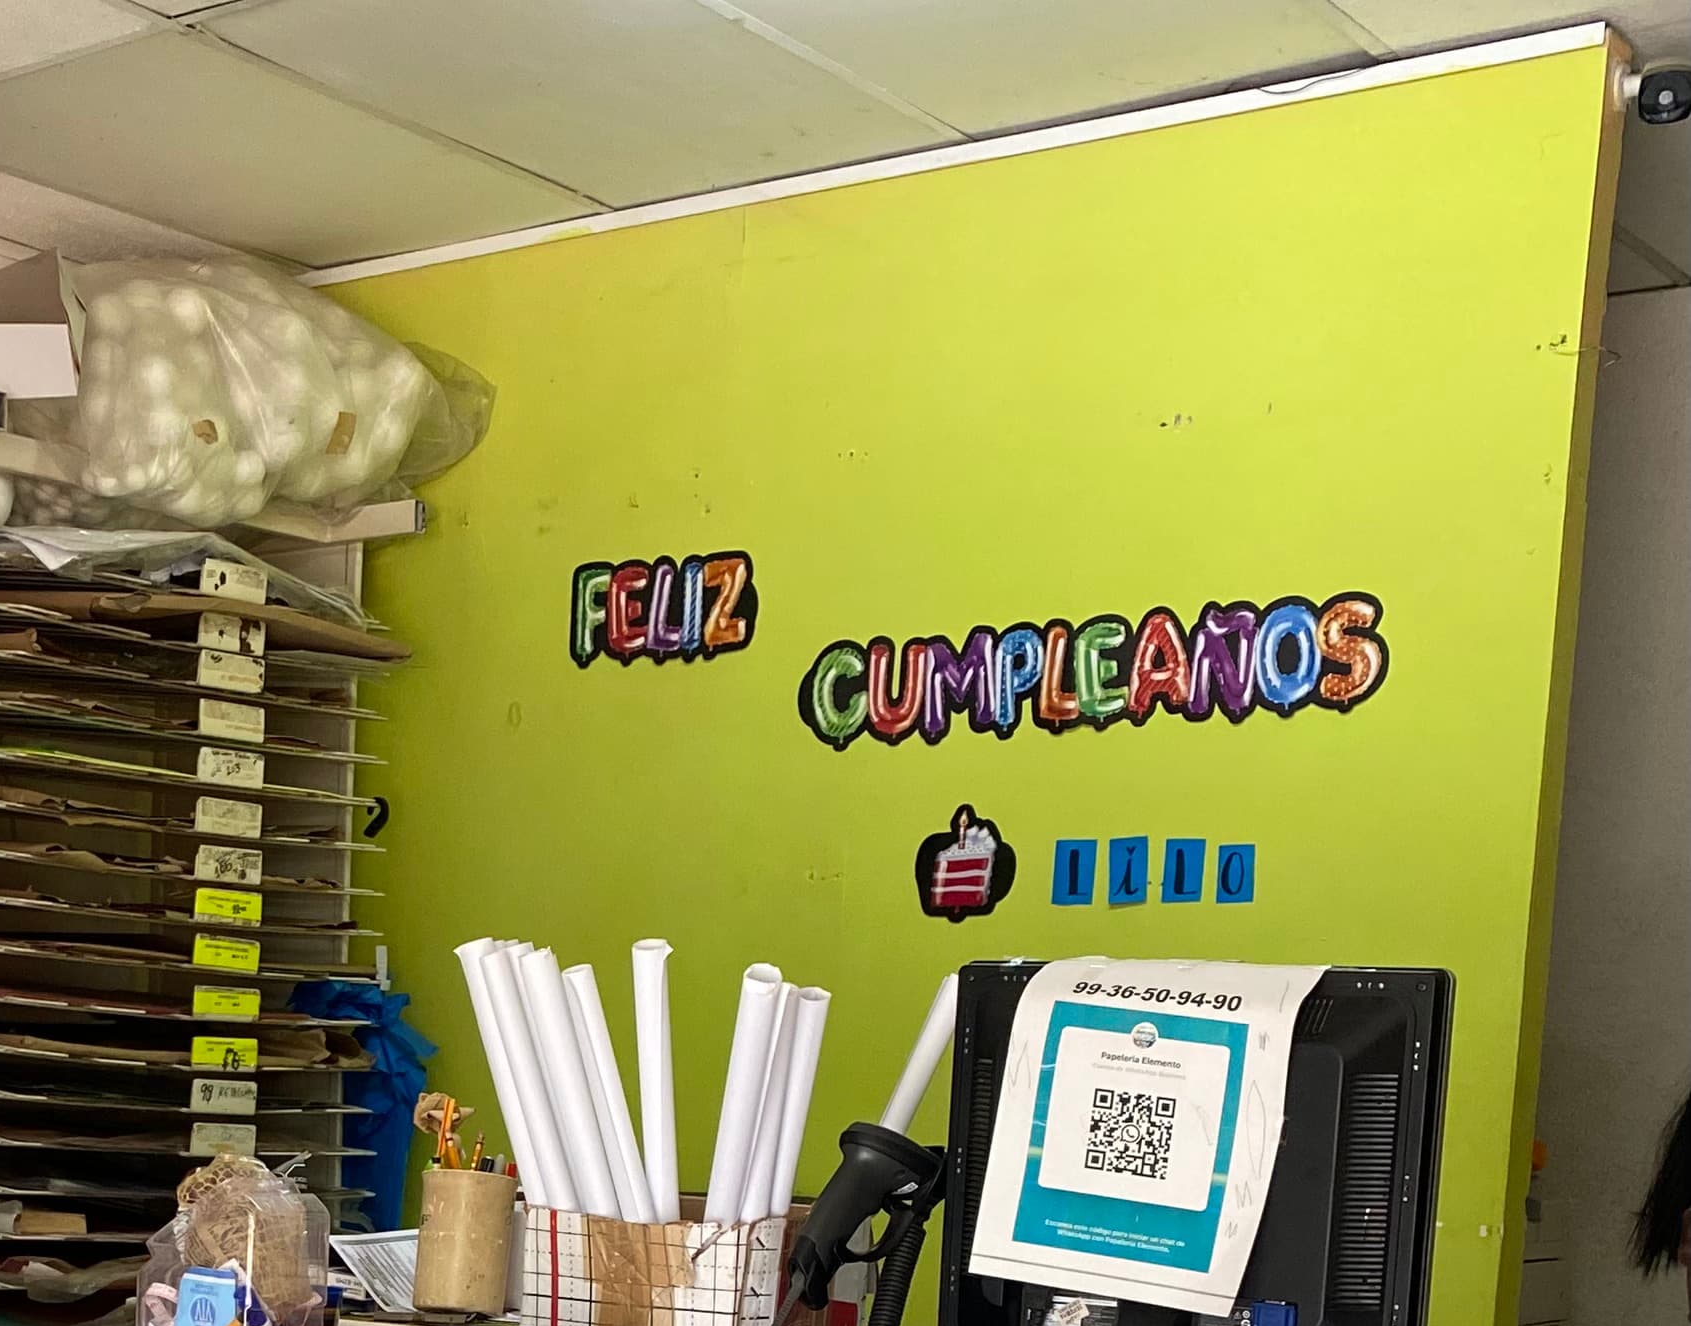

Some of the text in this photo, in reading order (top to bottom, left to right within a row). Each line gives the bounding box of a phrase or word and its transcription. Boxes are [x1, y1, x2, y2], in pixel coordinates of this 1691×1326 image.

[573, 552, 757, 667] FELIZ
[801, 593, 1388, 750] CUMPLEAÑOS
[1072, 981, 1243, 1012] 99-36-50-94-90
[1141, 1056, 1182, 1070] Elemento
